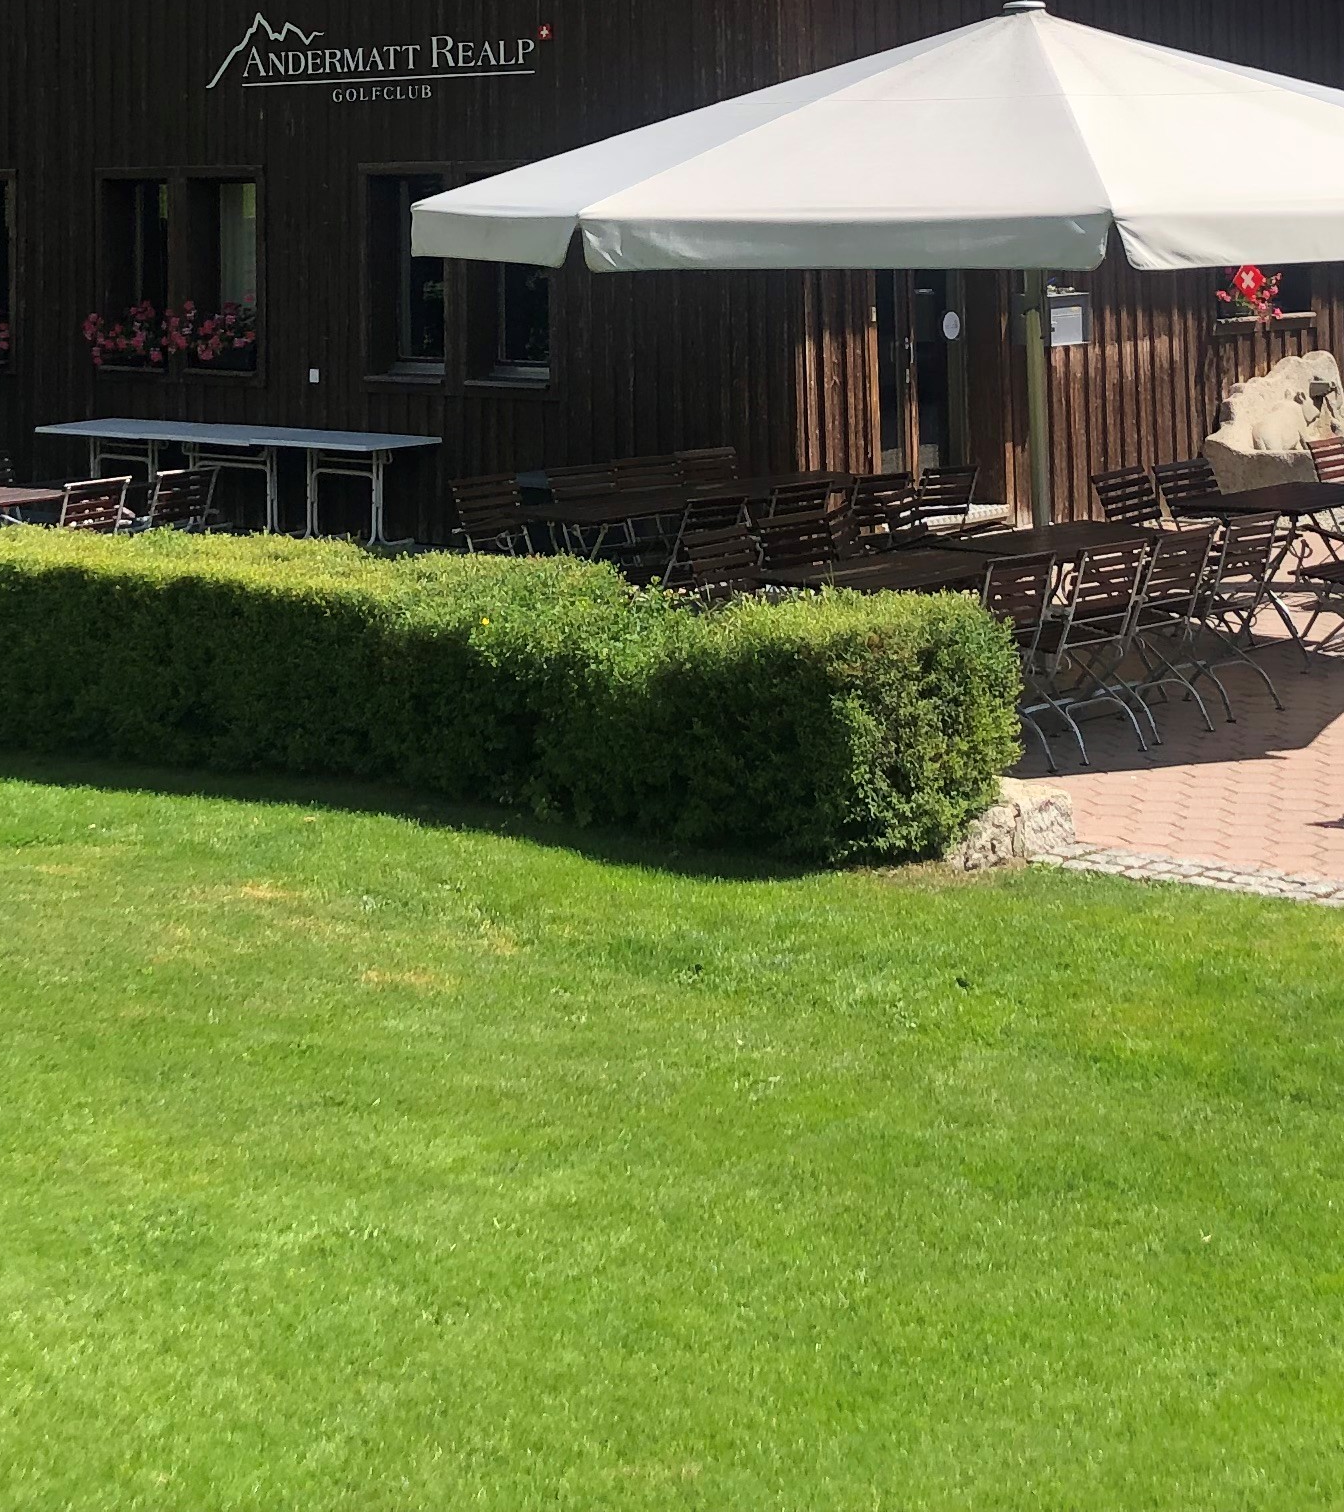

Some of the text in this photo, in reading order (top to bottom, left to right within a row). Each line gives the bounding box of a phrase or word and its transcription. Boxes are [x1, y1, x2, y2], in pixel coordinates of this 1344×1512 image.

[242, 35, 535, 77] ANDERMATT REALP
[332, 84, 433, 103] GOLFCLUB
